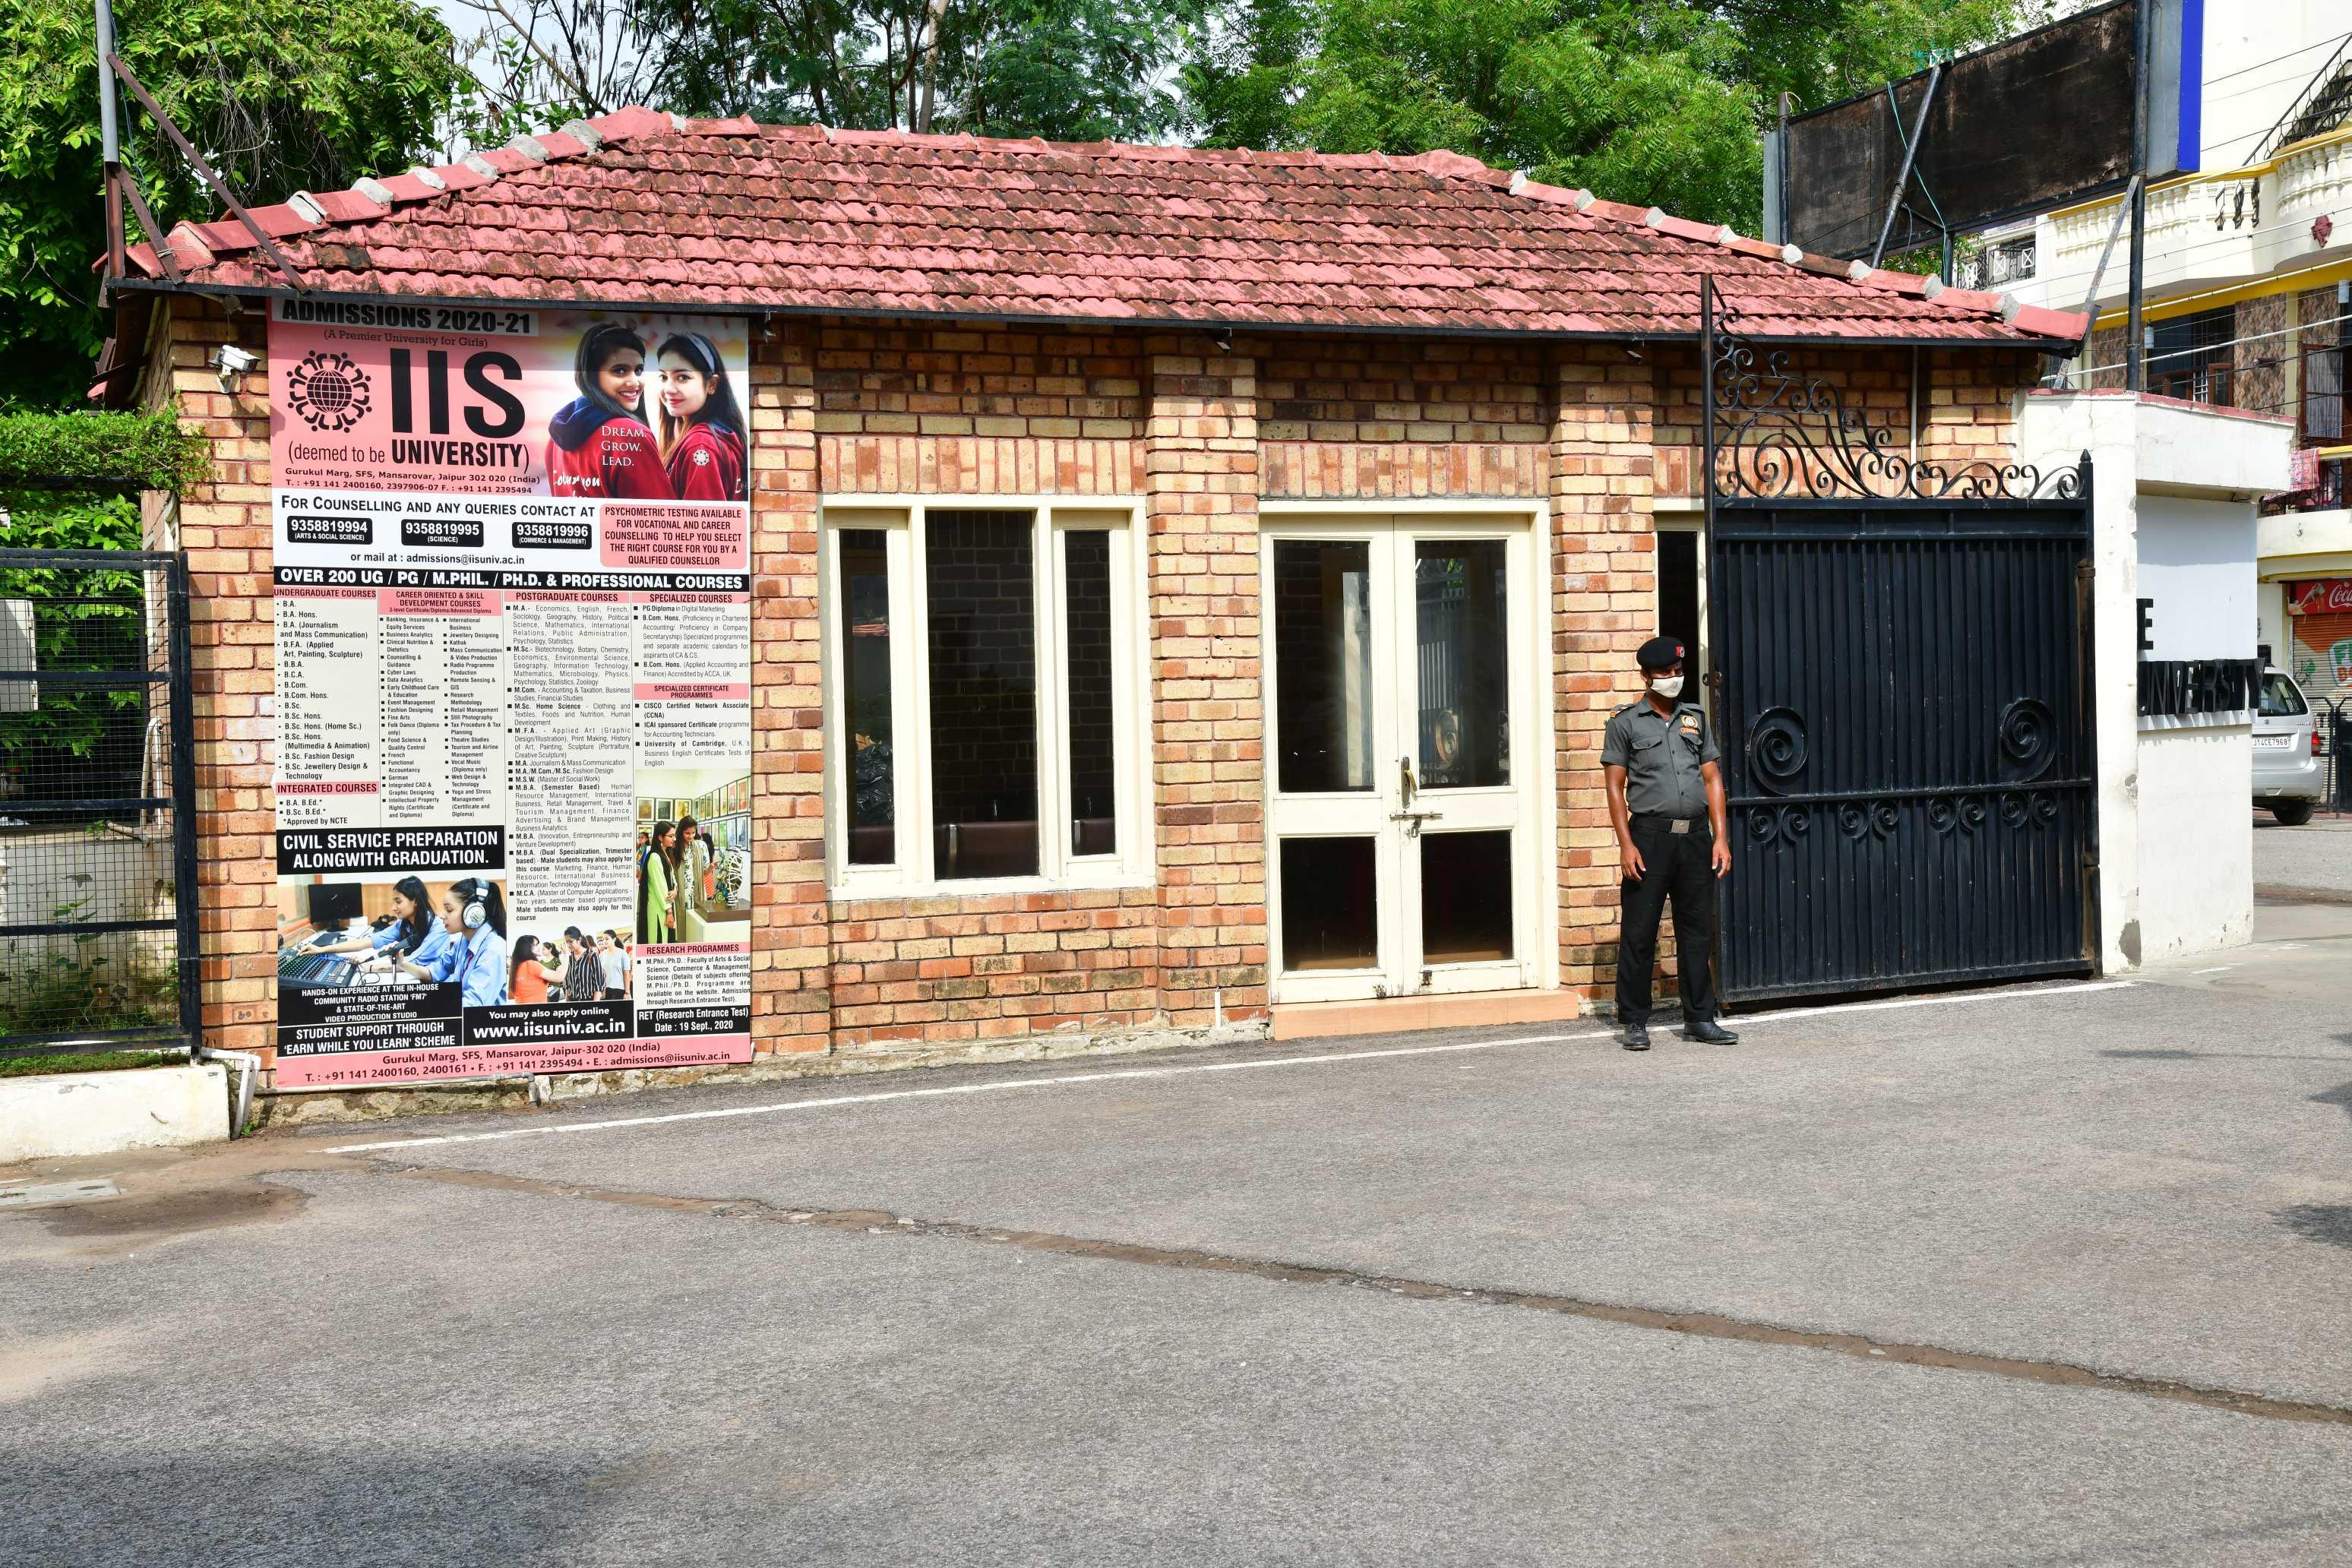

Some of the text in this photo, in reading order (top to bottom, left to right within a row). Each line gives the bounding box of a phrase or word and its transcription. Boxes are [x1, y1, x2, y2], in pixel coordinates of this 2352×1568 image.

[282, 299, 530, 333] ADMISSIONS 2020-21
[324, 329, 488, 348] (A Premier University for Girls)
[390, 348, 526, 438] IIS
[602, 425, 647, 437] DREAM.
[601, 440, 641, 451] GROW.
[288, 439, 530, 474] (deemed to be UNIVERSITY)
[602, 455, 634, 466] LEAD.
[285, 468, 323, 476] Gurukul
[326, 469, 352, 479] Marg,
[355, 470, 375, 479] SFS,
[378, 471, 435, 481] Mansarovar,
[438, 473, 466, 482] Jaipur
[508, 475, 540, 485] (India)
[281, 495, 595, 517] FOR COUNSELLING AND ANY QUERIES CONTACT AT
[605, 507, 741, 518] PSYCHOMETRIC TESTING AVAILABLE
[291, 520, 368, 533] 9358819994
[406, 523, 479, 535] 9358819995
[517, 524, 589, 537] 9358819996
[552, 537, 586, 545] MANAGEMENT)
[364, 552, 384, 561] mail
[387, 553, 397, 562] at
[406, 553, 524, 565] admissions@iisuniv.ac.in
[628, 555, 719, 565] QUALIFIED COUNSELLOR
[280, 568, 324, 583] OVER
[328, 569, 356, 583] 200
[361, 570, 383, 583] UG
[397, 571, 419, 584] PG
[432, 571, 488, 585] M.PHIL.
[502, 573, 542, 586] PH.D.
[546, 574, 558, 586] &
[561, 574, 672, 588] PROFESSIONAL
[675, 576, 742, 589] COURSES
[272, 588, 376, 598] UNDERGRADUATE COURSES
[516, 592, 618, 602] POSTGRADUATE COURSES
[650, 593, 732, 603] SPECIALIZED COURSES
[299, 621, 338, 629] (Journalism
[314, 631, 368, 639] Communication)
[653, 684, 729, 694] SPECIALIZED CERTIFICATE
[285, 742, 324, 751] (Multimedia
[334, 741, 370, 750] Animation)
[285, 772, 322, 780] Technology
[277, 783, 377, 793] INTEGRATED COURSES
[283, 830, 497, 850] CIVIL SERVICE PREPARATION
[292, 849, 488, 868] ALONGWITH GRADUATION.
[646, 944, 739, 954] RESEARCH PROGRAMMES
[302, 988, 337, 997] HANDS-ON
[314, 997, 356, 1005] COMMUNITY
[343, 1004, 406, 1013] STATE-OF-THE-ART
[509, 1011, 530, 1020] may
[531, 1009, 550, 1017] also
[552, 1007, 578, 1020] apply
[580, 1007, 609, 1015] online
[638, 1007, 748, 1021] RET (Research Entrance Test)
[347, 1013, 391, 1022] PRODUCTION
[296, 1022, 444, 1040] STUDENT SUPPORT THROUGH
[473, 1019, 625, 1038] www.iisuniv.ac.in
[655, 1023, 672, 1032] Date
[679, 1022, 689, 1031] 19
[691, 1021, 713, 1032] Sept.,
[714, 1020, 733, 1029] 2020
[318, 1041, 349, 1053] WHILE
[352, 1039, 374, 1051] YOU
[377, 1038, 412, 1049] LEARN'
[414, 1035, 455, 1047] SCHEME
